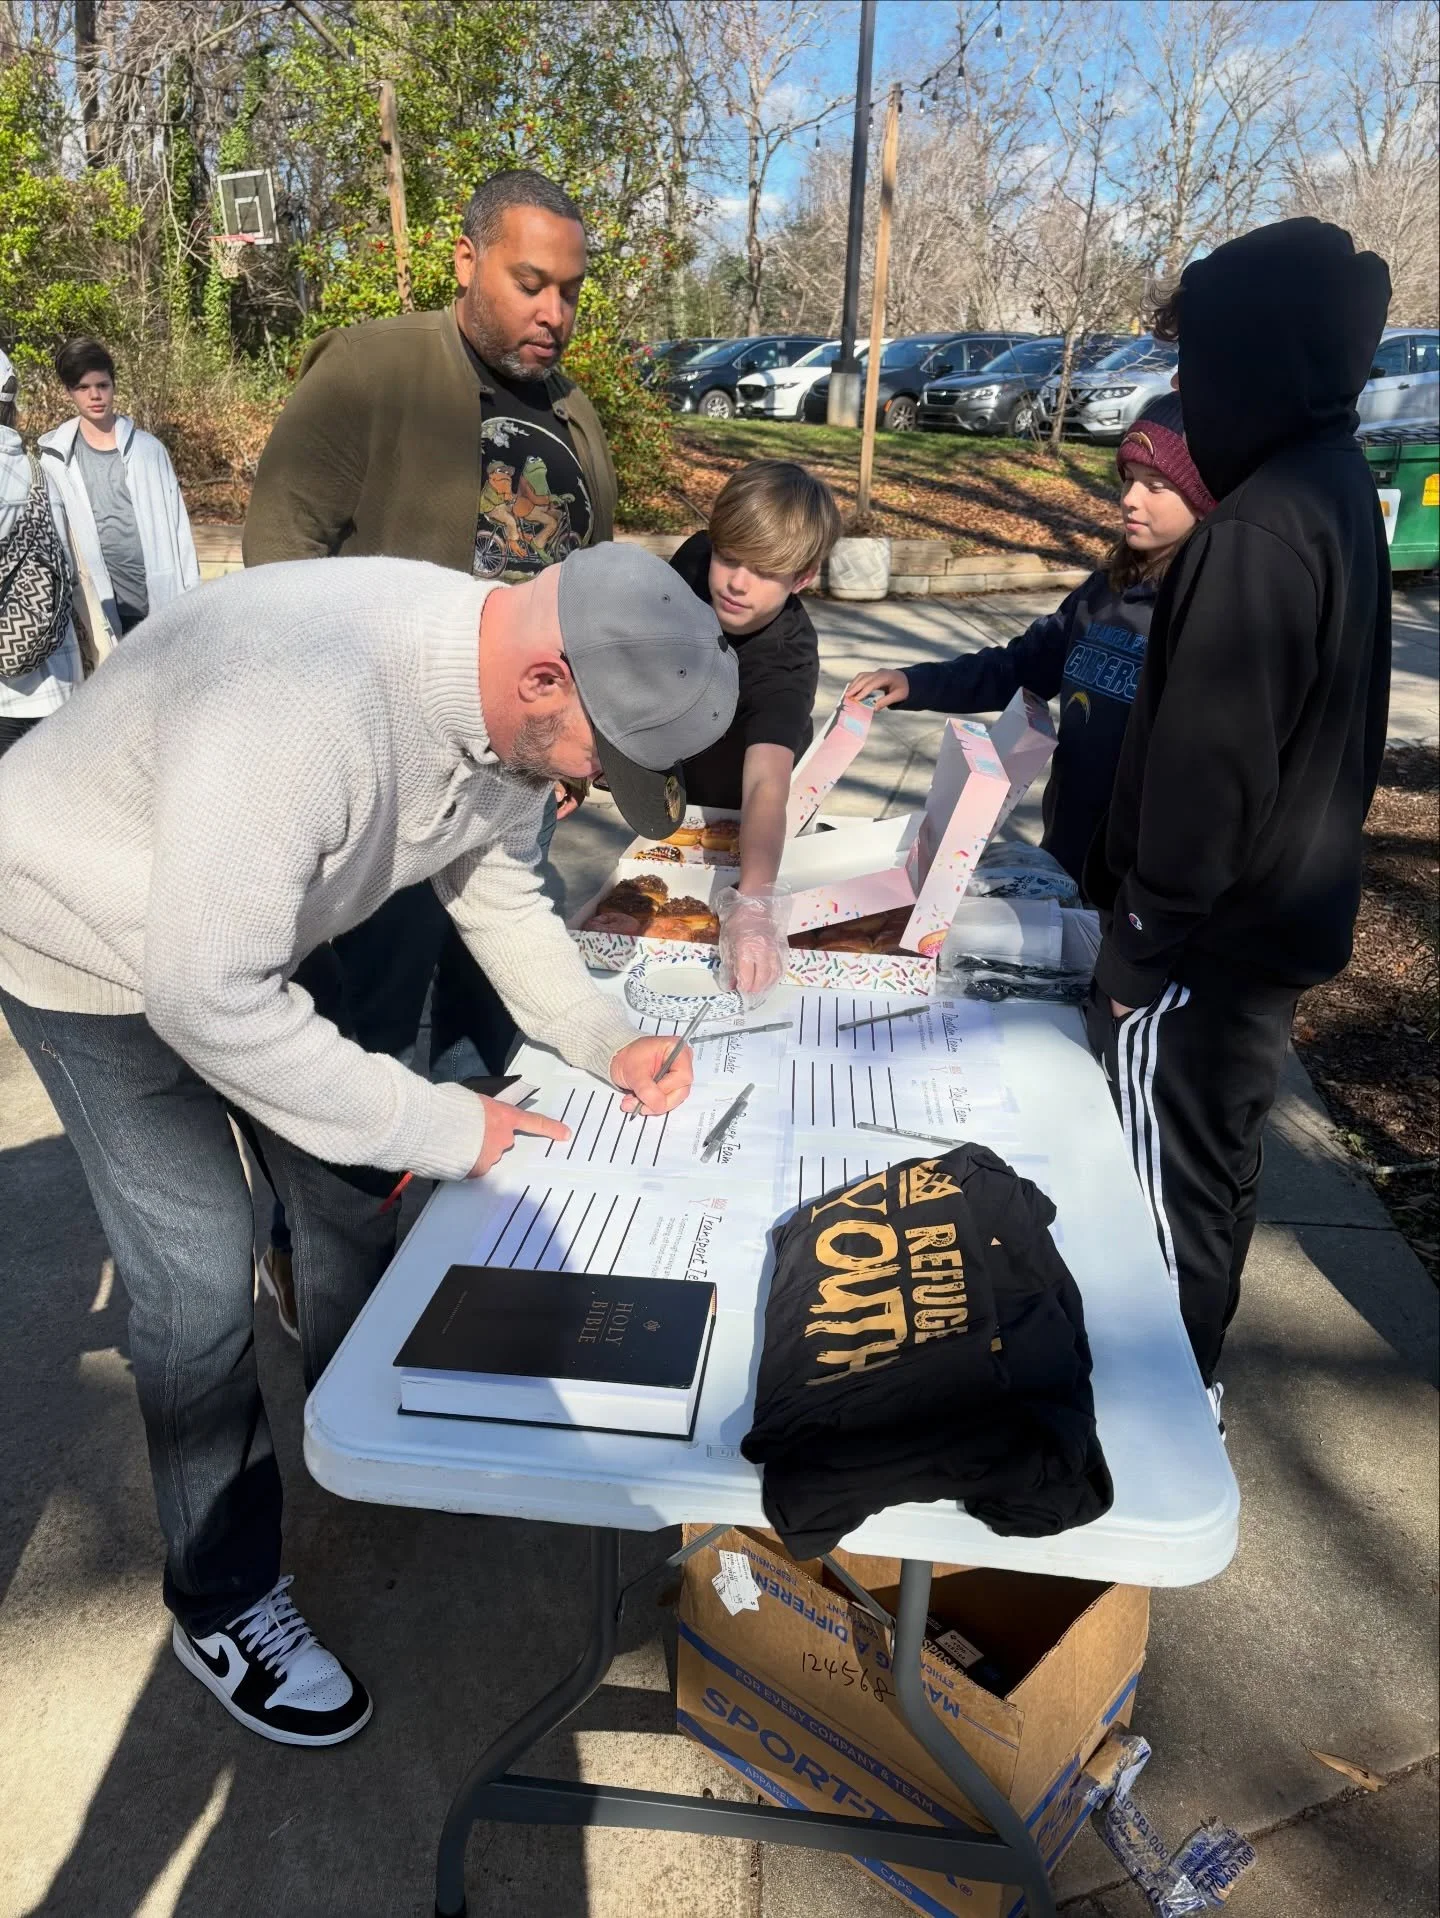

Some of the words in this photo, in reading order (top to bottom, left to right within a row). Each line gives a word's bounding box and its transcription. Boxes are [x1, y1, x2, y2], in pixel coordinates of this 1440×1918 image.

[726, 1052, 742, 1074] Leader
[947, 1037, 963, 1053] Team
[720, 1142, 741, 1164] Team
[691, 1213, 722, 1264] Transport
[805, 1170, 908, 1386] YOUTH
[904, 1223, 969, 1344] REFUGE
[578, 1300, 608, 1344] BIBLE
[605, 1301, 634, 1347] HOLY
[753, 1571, 850, 1644] DIFFEREN
[735, 1667, 763, 1692] FOR
[764, 1686, 805, 1722] EVERY
[809, 1720, 878, 1773] COMPANY
[880, 1768, 889, 1781] &
[894, 1779, 934, 1813] TEAM
[744, 1766, 793, 1807] APPAREL
[880, 1867, 914, 1896] CAPS
